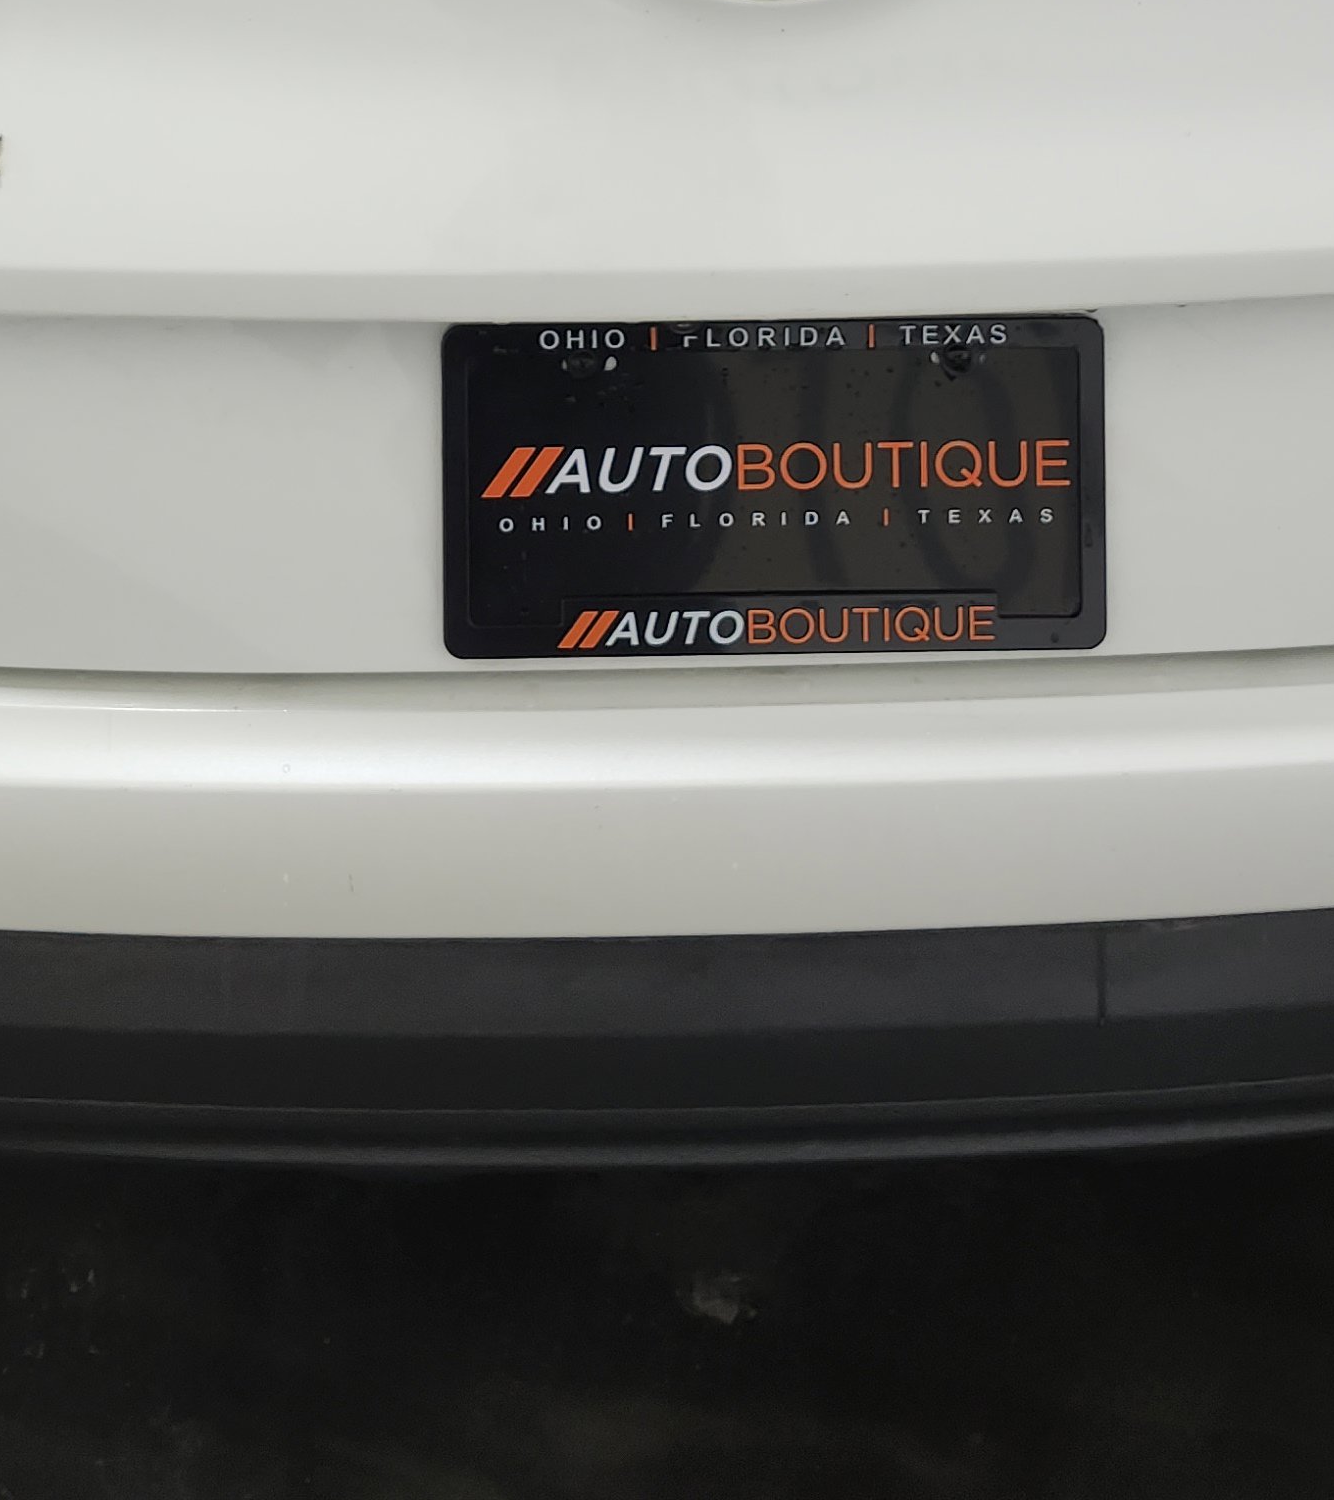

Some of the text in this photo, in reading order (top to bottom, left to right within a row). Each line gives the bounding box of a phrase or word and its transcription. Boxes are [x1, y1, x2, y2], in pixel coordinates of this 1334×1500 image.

[539, 328, 626, 350] OHIO
[900, 323, 1008, 345] TEXAS
[499, 507, 1054, 532] OHIO FLORIDA TEXAS
